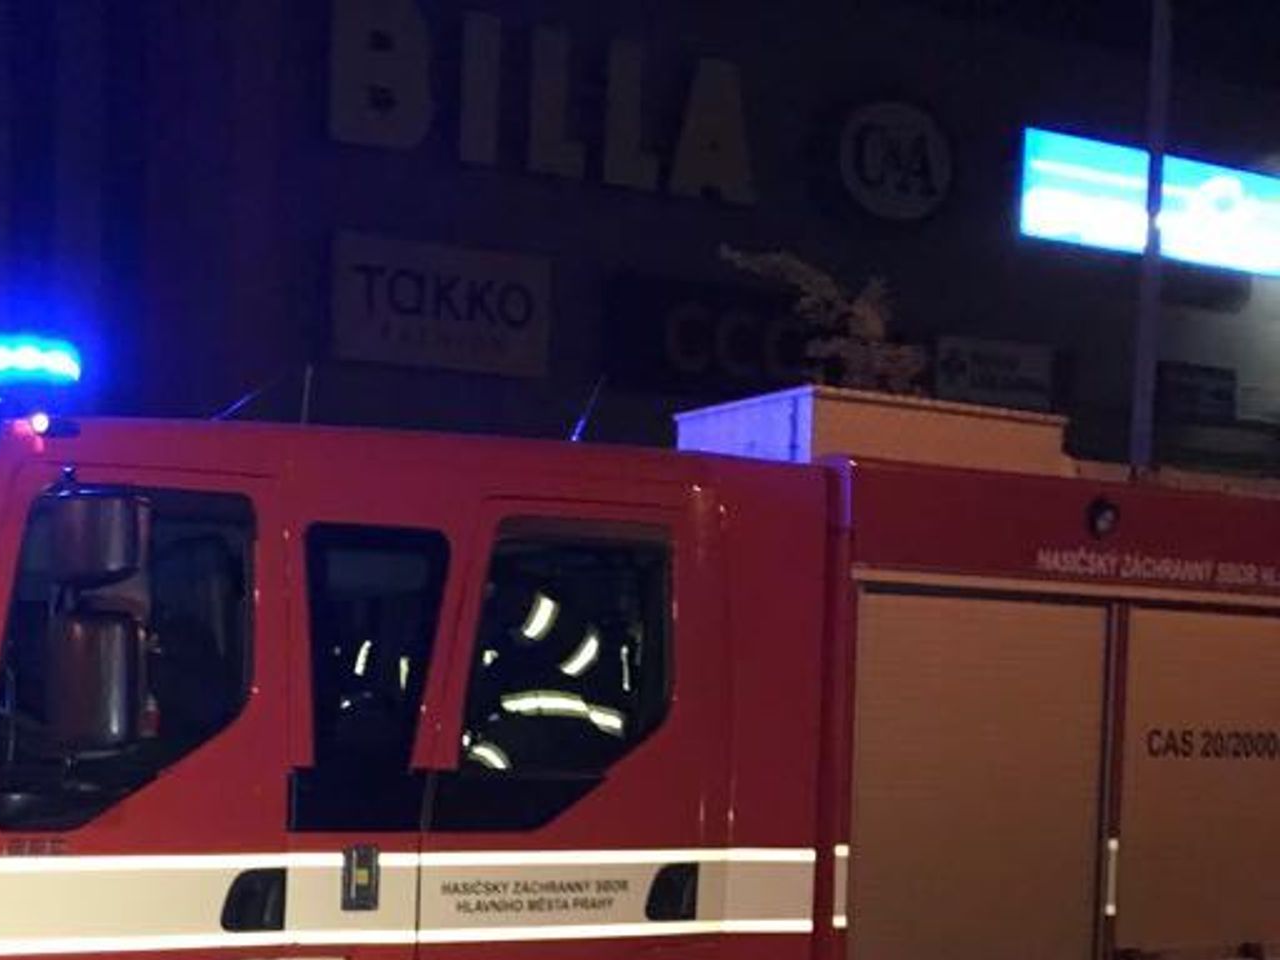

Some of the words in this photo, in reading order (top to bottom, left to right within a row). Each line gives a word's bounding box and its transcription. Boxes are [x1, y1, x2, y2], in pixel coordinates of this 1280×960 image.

[329, 0, 756, 206] BILLA
[852, 123, 938, 197] C&A
[1146, 728, 1194, 758] CAS
